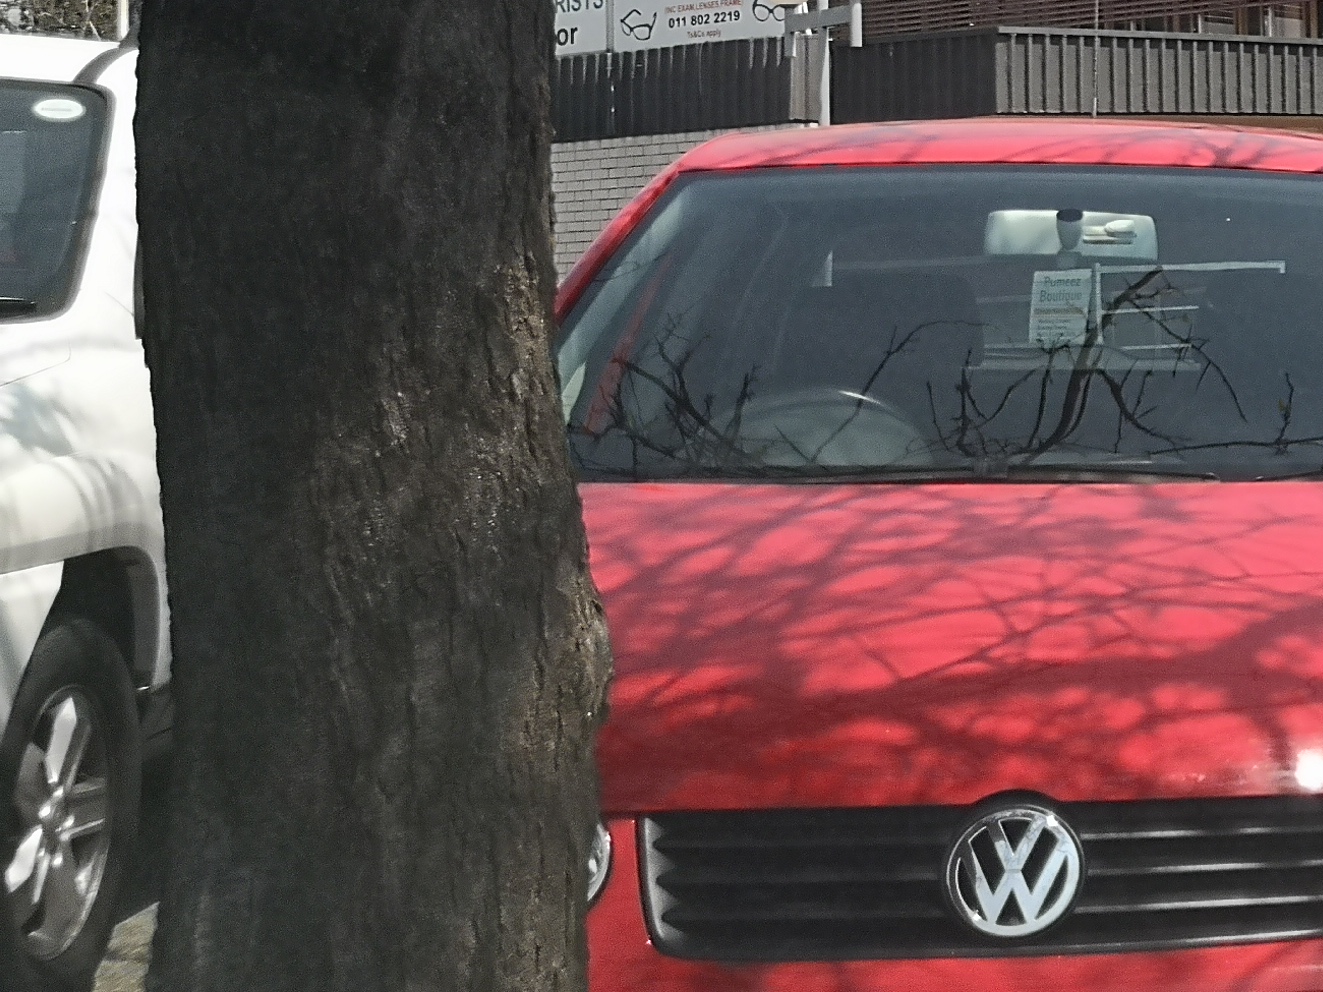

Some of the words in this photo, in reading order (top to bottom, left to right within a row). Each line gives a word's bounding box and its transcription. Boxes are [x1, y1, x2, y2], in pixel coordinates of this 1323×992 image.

[668, 16, 686, 28] 011
[690, 14, 710, 26] 802
[714, 10, 740, 24] 2219
[557, 27, 578, 46] or
[1040, 290, 1082, 303] Boutique
